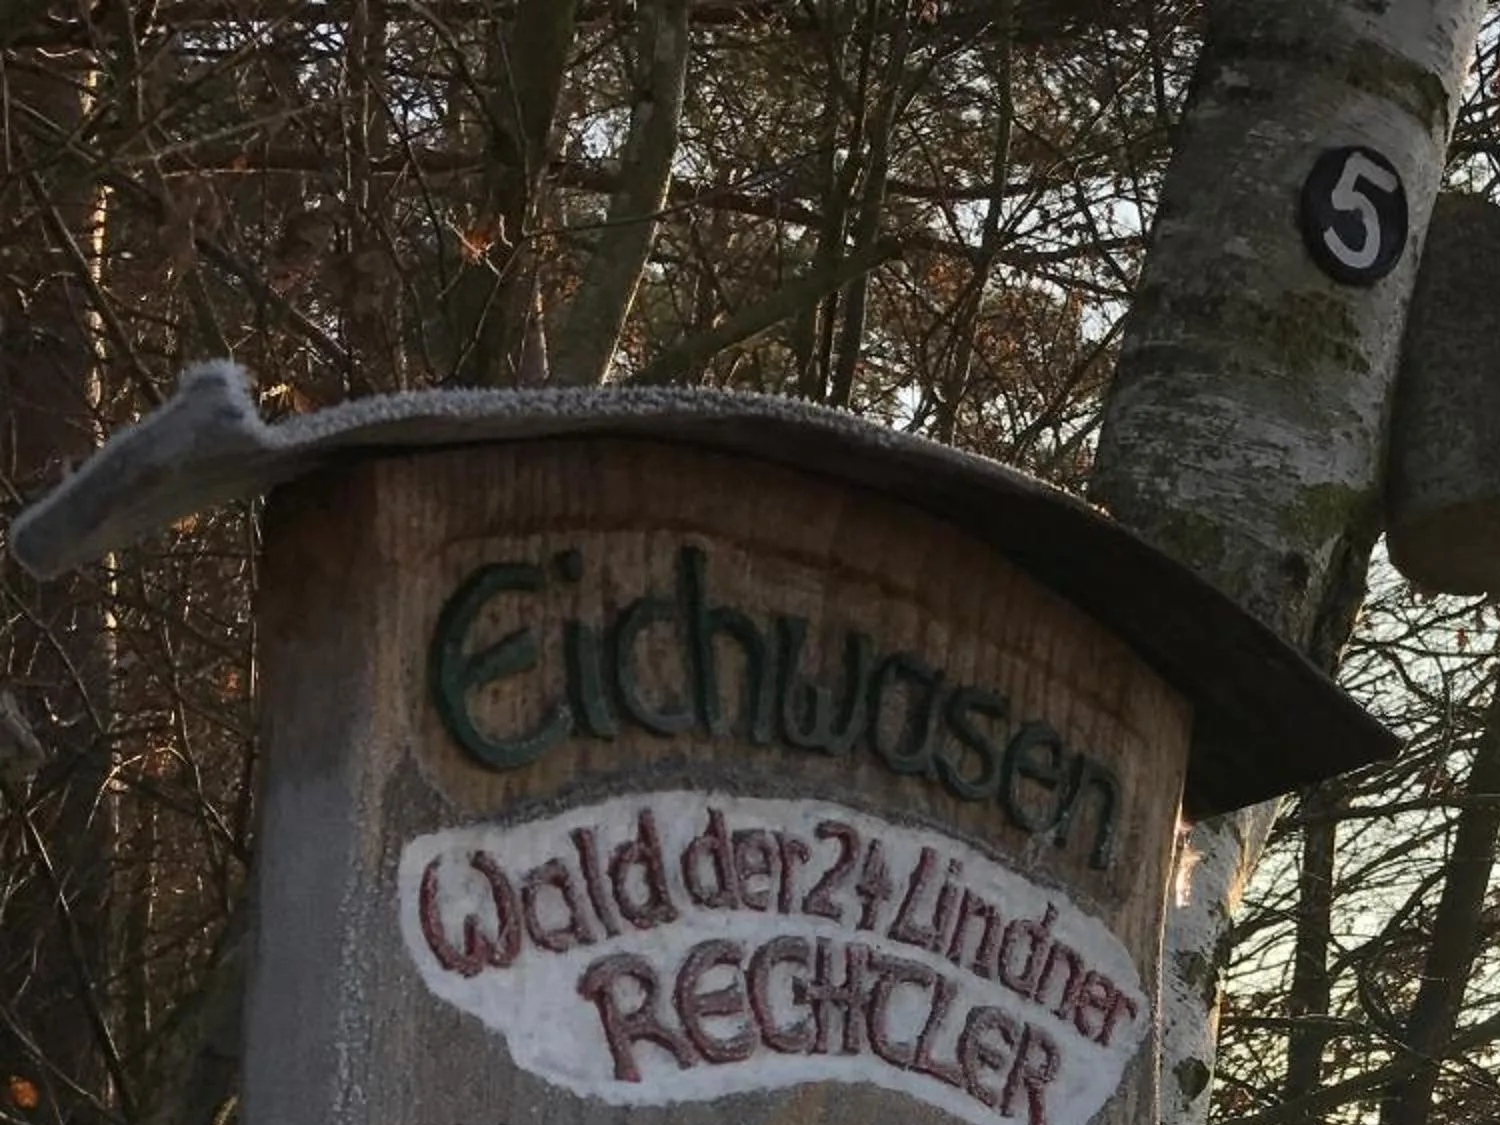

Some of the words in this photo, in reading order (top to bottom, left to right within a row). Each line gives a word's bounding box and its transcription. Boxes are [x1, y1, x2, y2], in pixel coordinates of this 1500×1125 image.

[1323, 152, 1398, 270] 5
[429, 547, 1122, 870] Eichwasen
[418, 806, 678, 978] Wald
[679, 806, 811, 915] der
[889, 844, 1138, 1047] Lindner
